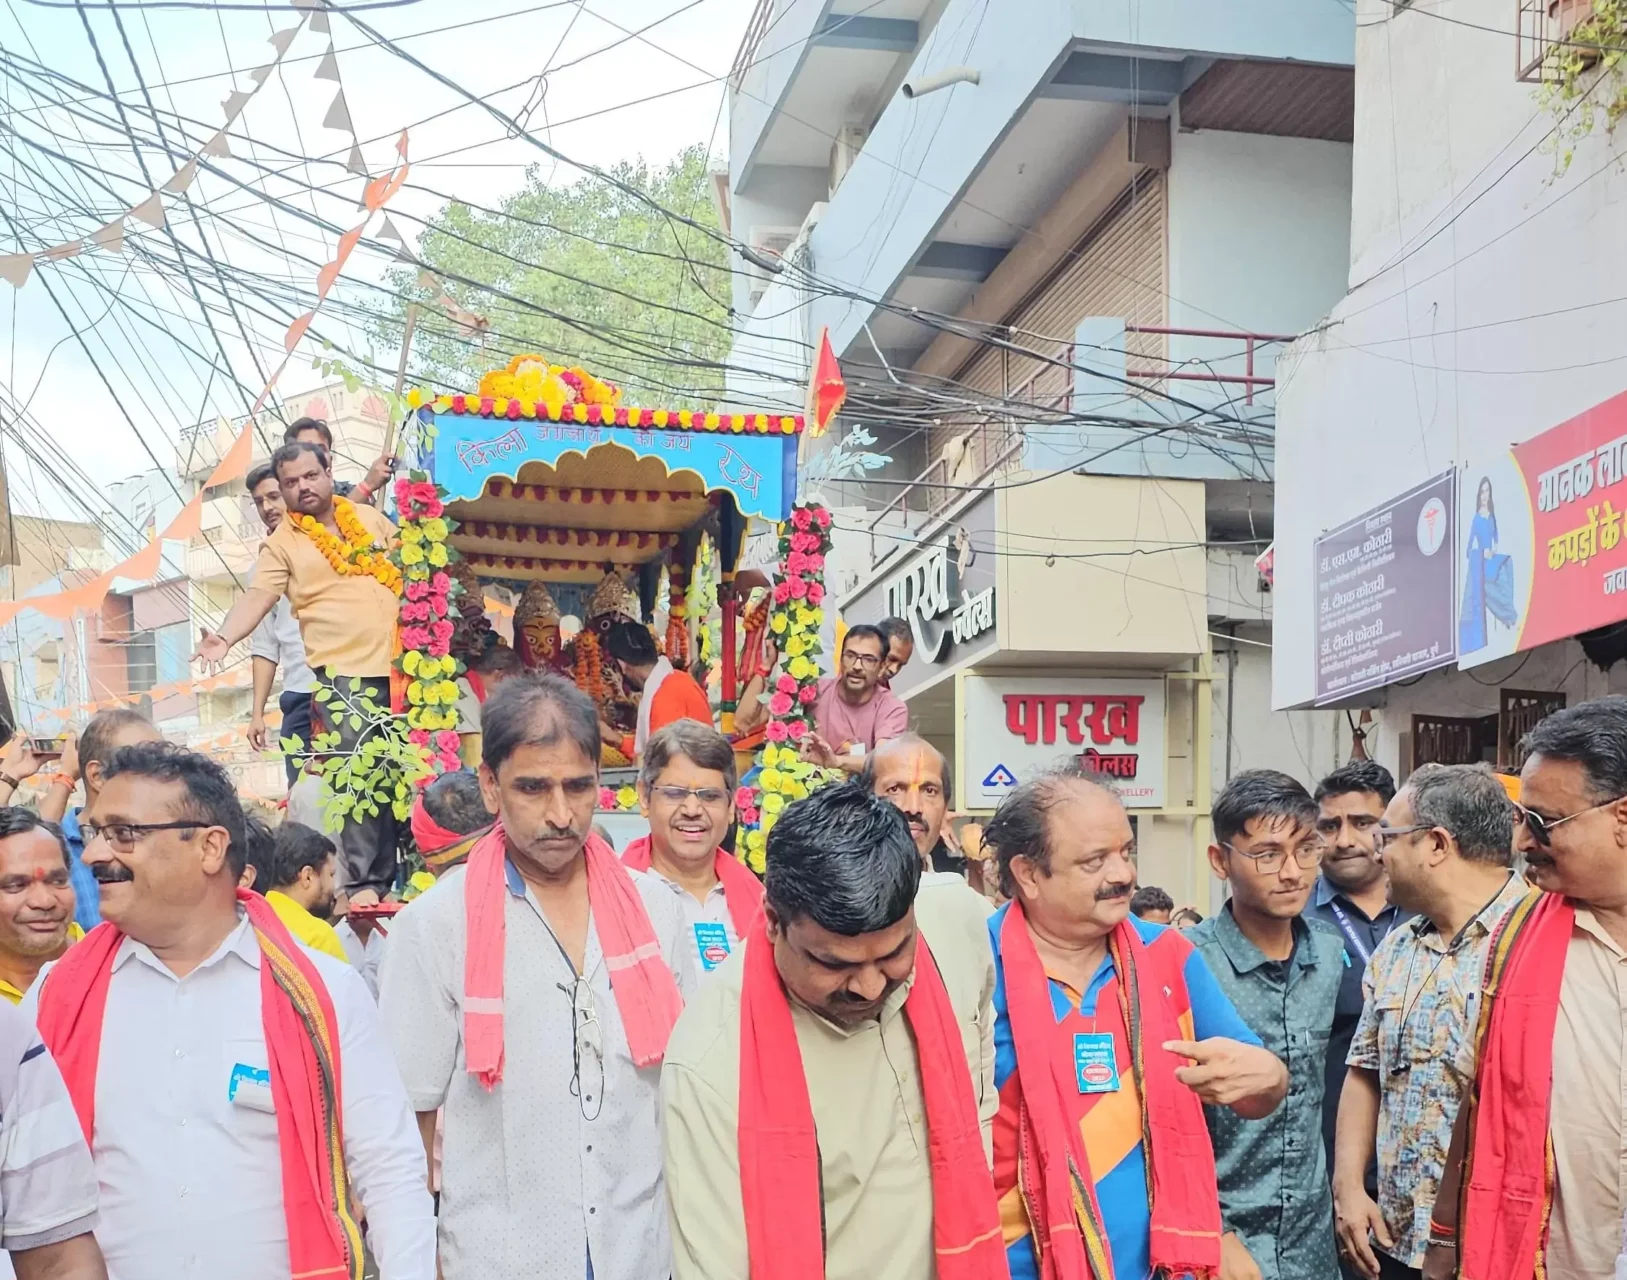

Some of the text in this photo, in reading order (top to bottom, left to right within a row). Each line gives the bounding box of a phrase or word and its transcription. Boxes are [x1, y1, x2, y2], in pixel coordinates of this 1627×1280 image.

[660, 433, 695, 451] जय
[715, 442, 763, 500] रथ
[1538, 450, 1596, 512] मानक
[1600, 499, 1622, 550] के
[1603, 566, 1627, 595] जव
[1002, 694, 1146, 745] पारख
[1118, 788, 1154, 797] WELLERY
